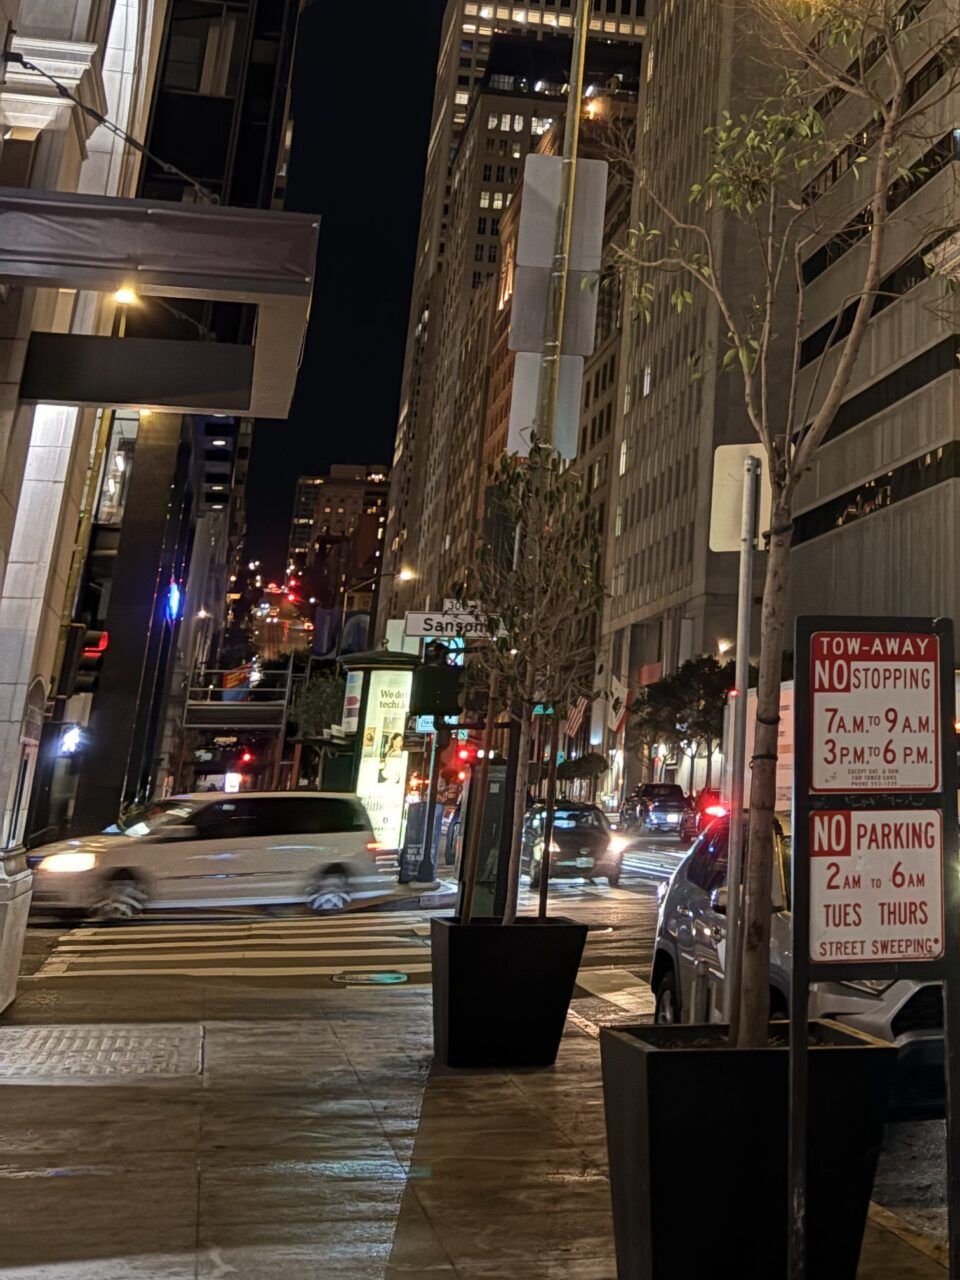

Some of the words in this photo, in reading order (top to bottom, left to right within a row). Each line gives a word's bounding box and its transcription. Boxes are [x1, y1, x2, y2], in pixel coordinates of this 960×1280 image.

[820, 637, 929, 655] TOW-AWAY
[814, 659, 848, 690] NO
[852, 667, 931, 689] STOPPING
[868, 716, 880, 726] TO
[868, 746, 880, 757] TO
[813, 814, 846, 852] NO
[856, 822, 935, 850] PARKING
[871, 878, 882, 889] TO
[823, 902, 862, 928] TUES
[878, 901, 928, 926] THURS
[819, 940, 866, 957] STREET
[871, 938, 932, 956] SWEEPING
